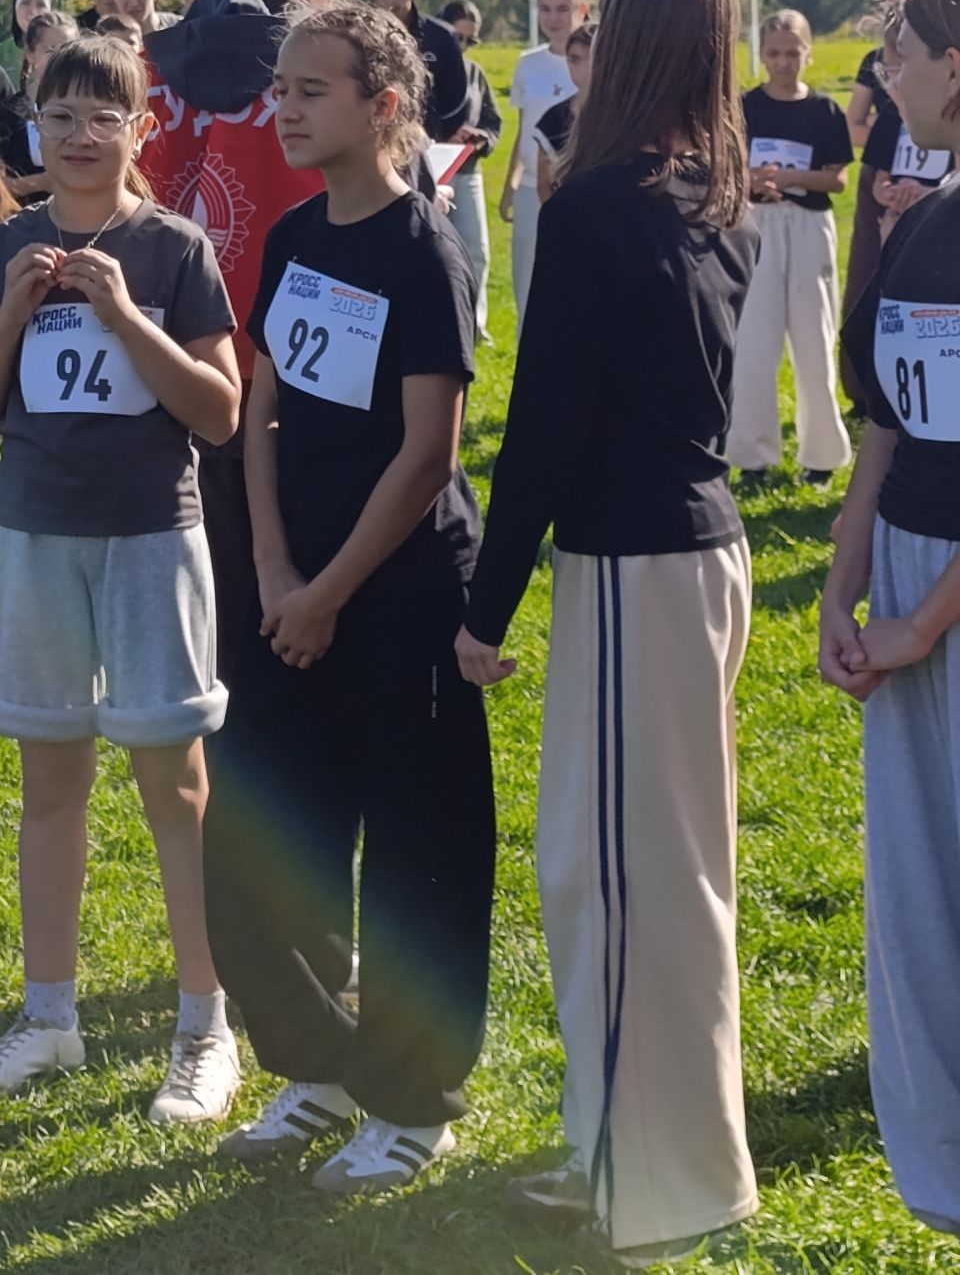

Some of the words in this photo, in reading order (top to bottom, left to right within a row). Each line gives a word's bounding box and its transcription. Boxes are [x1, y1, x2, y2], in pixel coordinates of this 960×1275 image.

[288, 271, 322, 288] КРОСС
[287, 285, 322, 301] НАЦИИ
[32, 306, 77, 325] КРОСС
[37, 317, 82, 335] НАЦИИ
[346, 326, 378, 342] АРСК
[284, 318, 329, 383] 92
[56, 348, 112, 402] 94
[896, 356, 928, 424] 81
